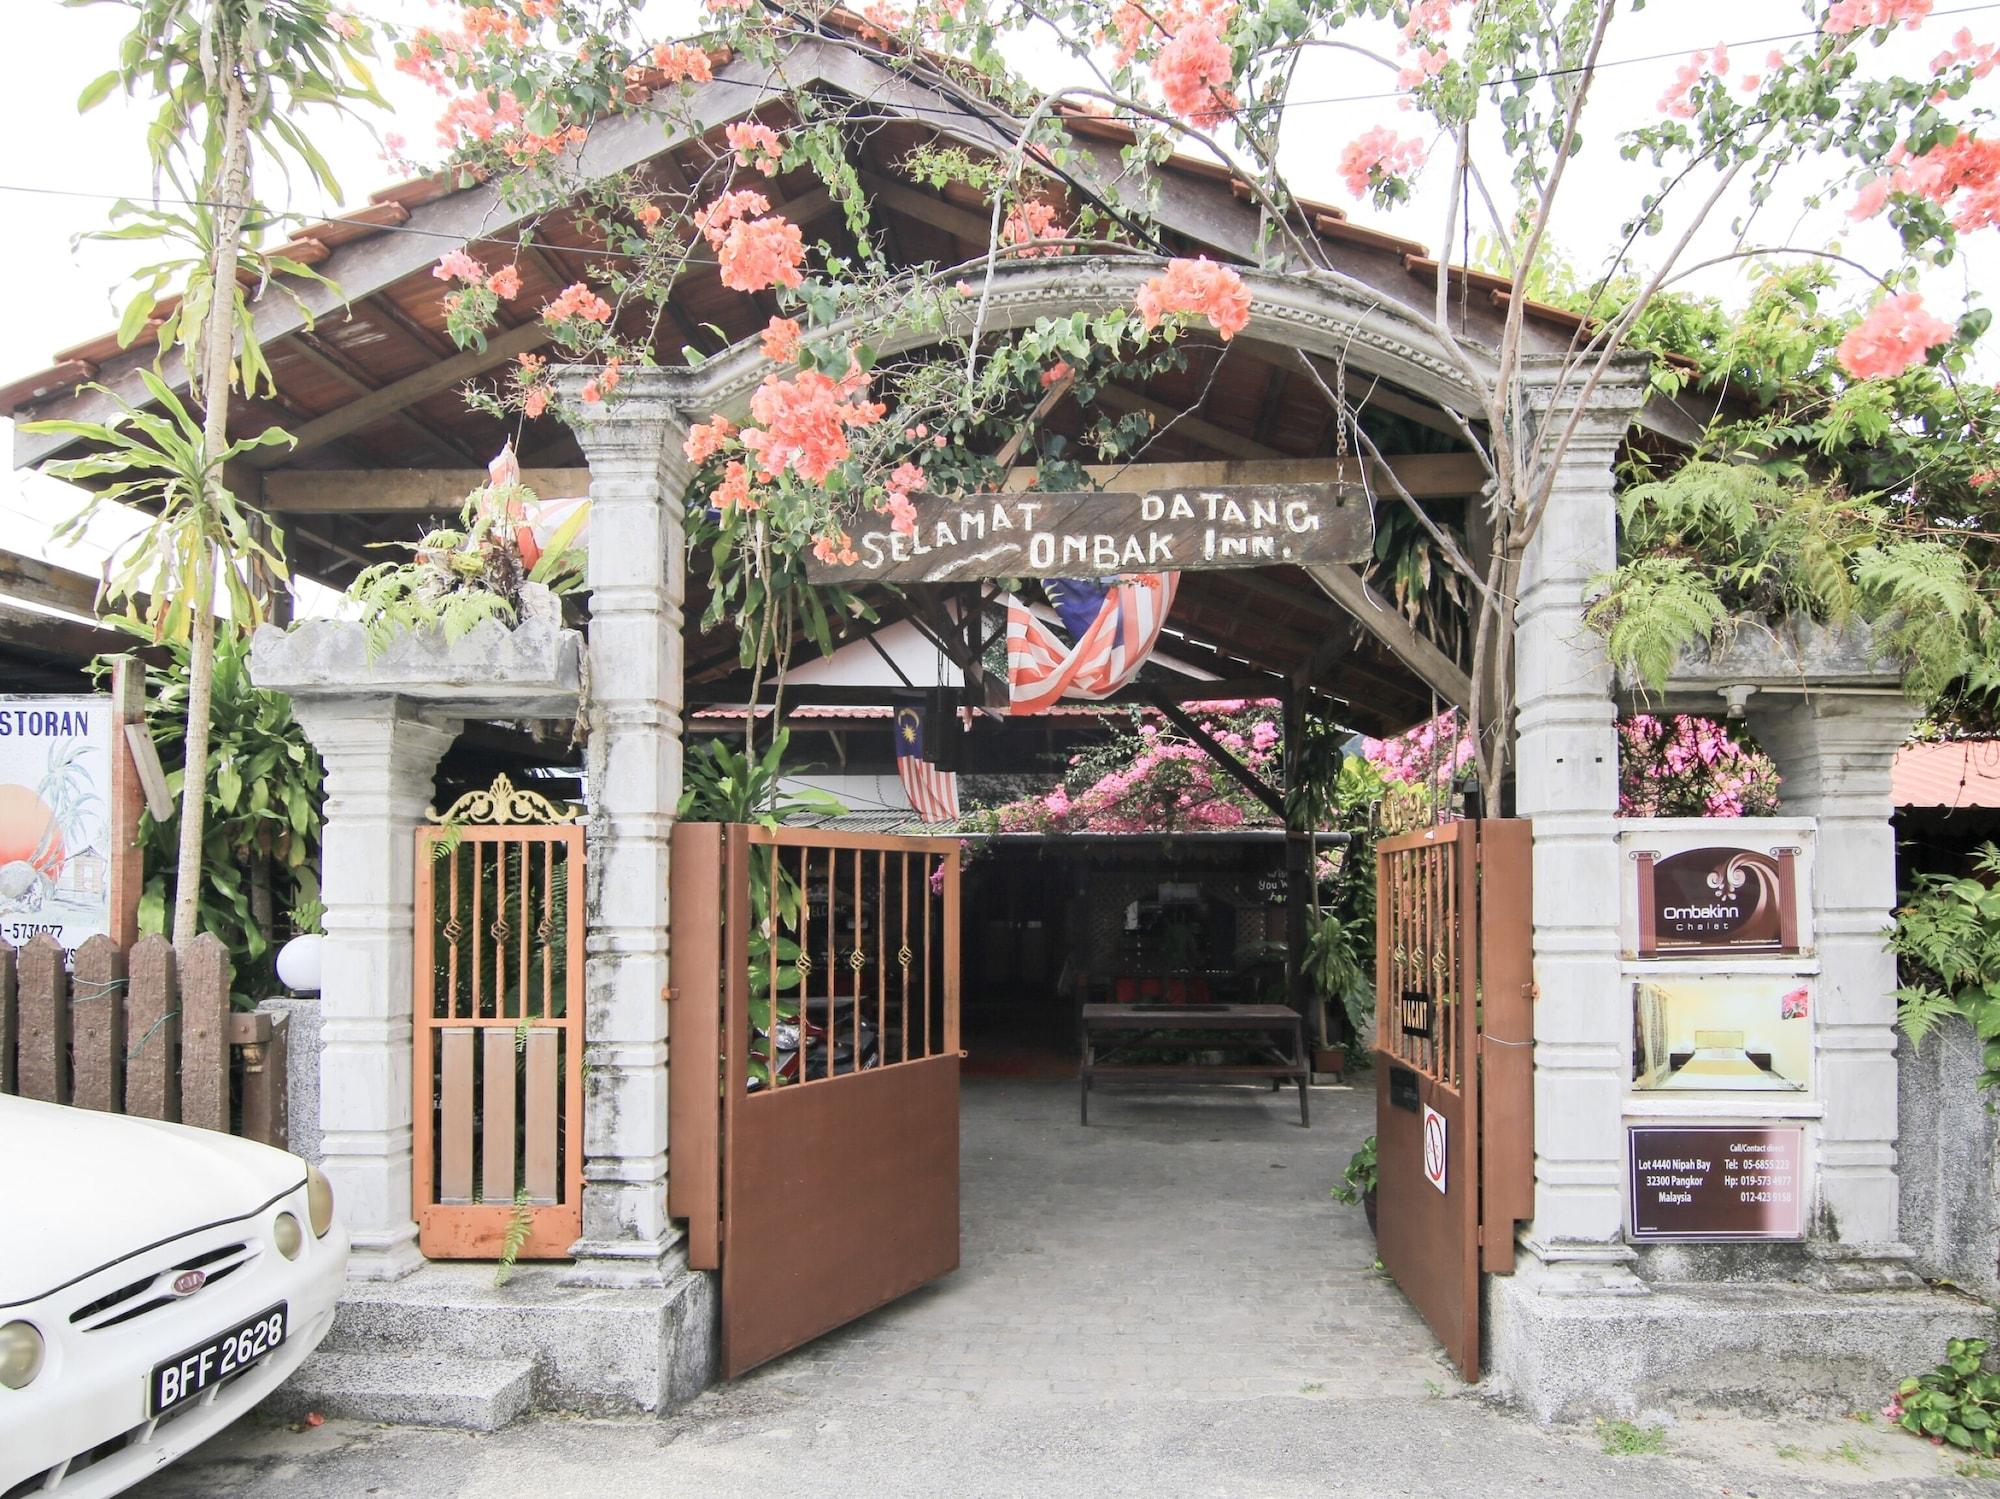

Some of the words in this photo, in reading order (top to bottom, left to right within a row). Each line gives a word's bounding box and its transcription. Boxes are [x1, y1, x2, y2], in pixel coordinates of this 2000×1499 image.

[862, 502, 1042, 569] SELAMAT
[1142, 493, 1320, 534] DATANG
[1029, 531, 1173, 569] OMBAK
[1664, 904, 1739, 919] Ombakinn
[1403, 1000, 1427, 1030] VACANT
[1639, 1159, 1651, 1170] Lot
[1652, 1159, 1671, 1170] 4440
[1672, 1159, 1695, 1172] Nipah
[1696, 1159, 1711, 1172] Bay
[1724, 1159, 1739, 1169] Tel:
[1646, 1176, 1670, 1186] 32300
[1671, 1175, 1703, 1188] Pangkor
[1724, 1176, 1739, 1188] Hp:
[1741, 1176, 1771, 1185] 019-573
[1659, 1191, 1692, 1205] Malaysia
[1741, 1192, 1771, 1202] 012-423
[178, 1273, 203, 1290] KIA
[160, 1345, 217, 1408] BFF
[220, 1313, 283, 1376] 2628
